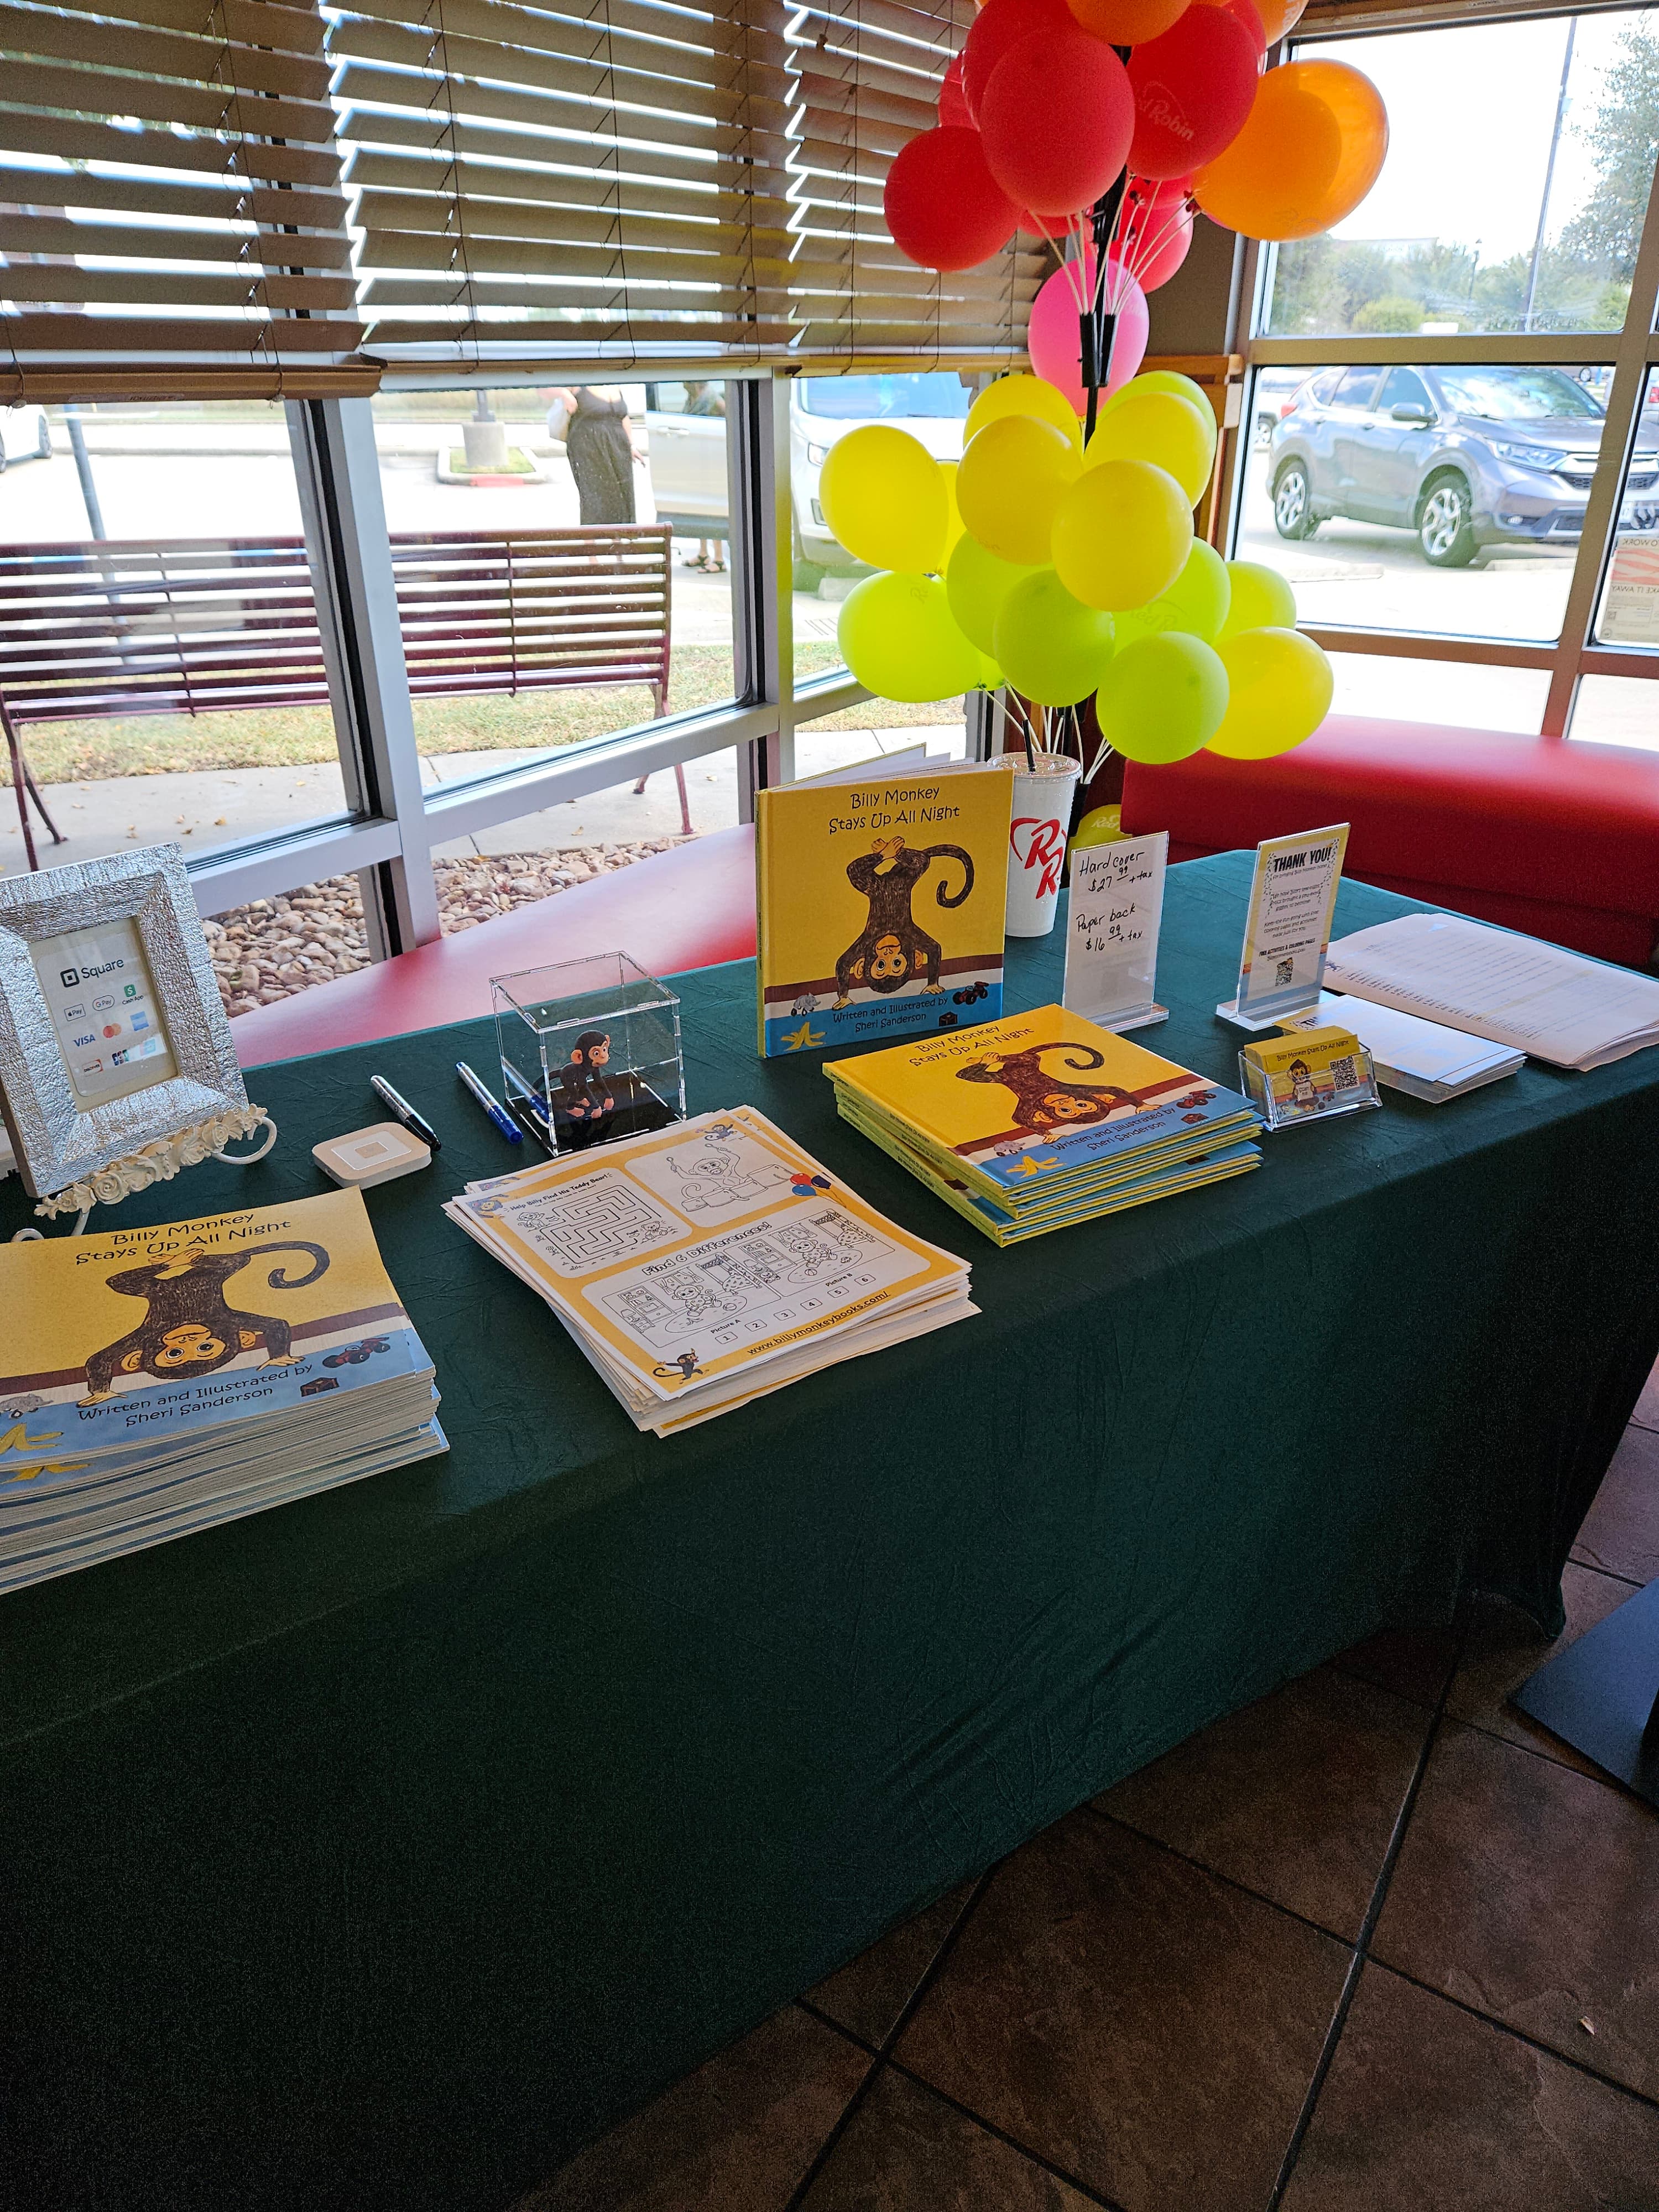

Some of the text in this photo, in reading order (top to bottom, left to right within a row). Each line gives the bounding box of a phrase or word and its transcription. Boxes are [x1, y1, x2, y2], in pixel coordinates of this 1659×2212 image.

[1149, 100, 1194, 141] Robin
[850, 787, 940, 809] Billy Monkey
[829, 805, 960, 835] Stays Up All Night
[1137, 870, 1152, 878] tax
[1274, 847, 1332, 873] THANK YOU!
[1076, 902, 1136, 933] Paper back
[1128, 929, 1142, 939] tax
[81, 958, 124, 980] Square
[833, 997, 948, 1024] Written and Illustrated by
[855, 1013, 926, 1033] Sheri Sanderson
[73, 1034, 96, 1047] VISA
[909, 1027, 1035, 1066] Stays Up All Night
[915, 1026, 1000, 1053] Billy Monkey
[1051, 1135, 1092, 1150] Written
[1094, 1129, 1112, 1138] and
[1112, 1112, 1163, 1132] Illustrated
[1087, 1121, 1166, 1151] Sheri Sanderson
[526, 1198, 542, 1206] Billy
[569, 1182, 589, 1190] Teddy
[590, 1174, 608, 1183] Bear!
[76, 1220, 292, 1265] Stays Up All Night
[111, 1214, 254, 1246] Billy Monkey
[641, 1221, 773, 1276] Find 6 Differences!
[825, 1277, 844, 1287] Picture
[711, 1322, 734, 1334] Picture
[747, 1290, 892, 1355] www.billymonkeybooks.com/
[78, 1364, 313, 1421] Written and Illustrated by
[126, 1387, 273, 1427] Sheri Sanderson
